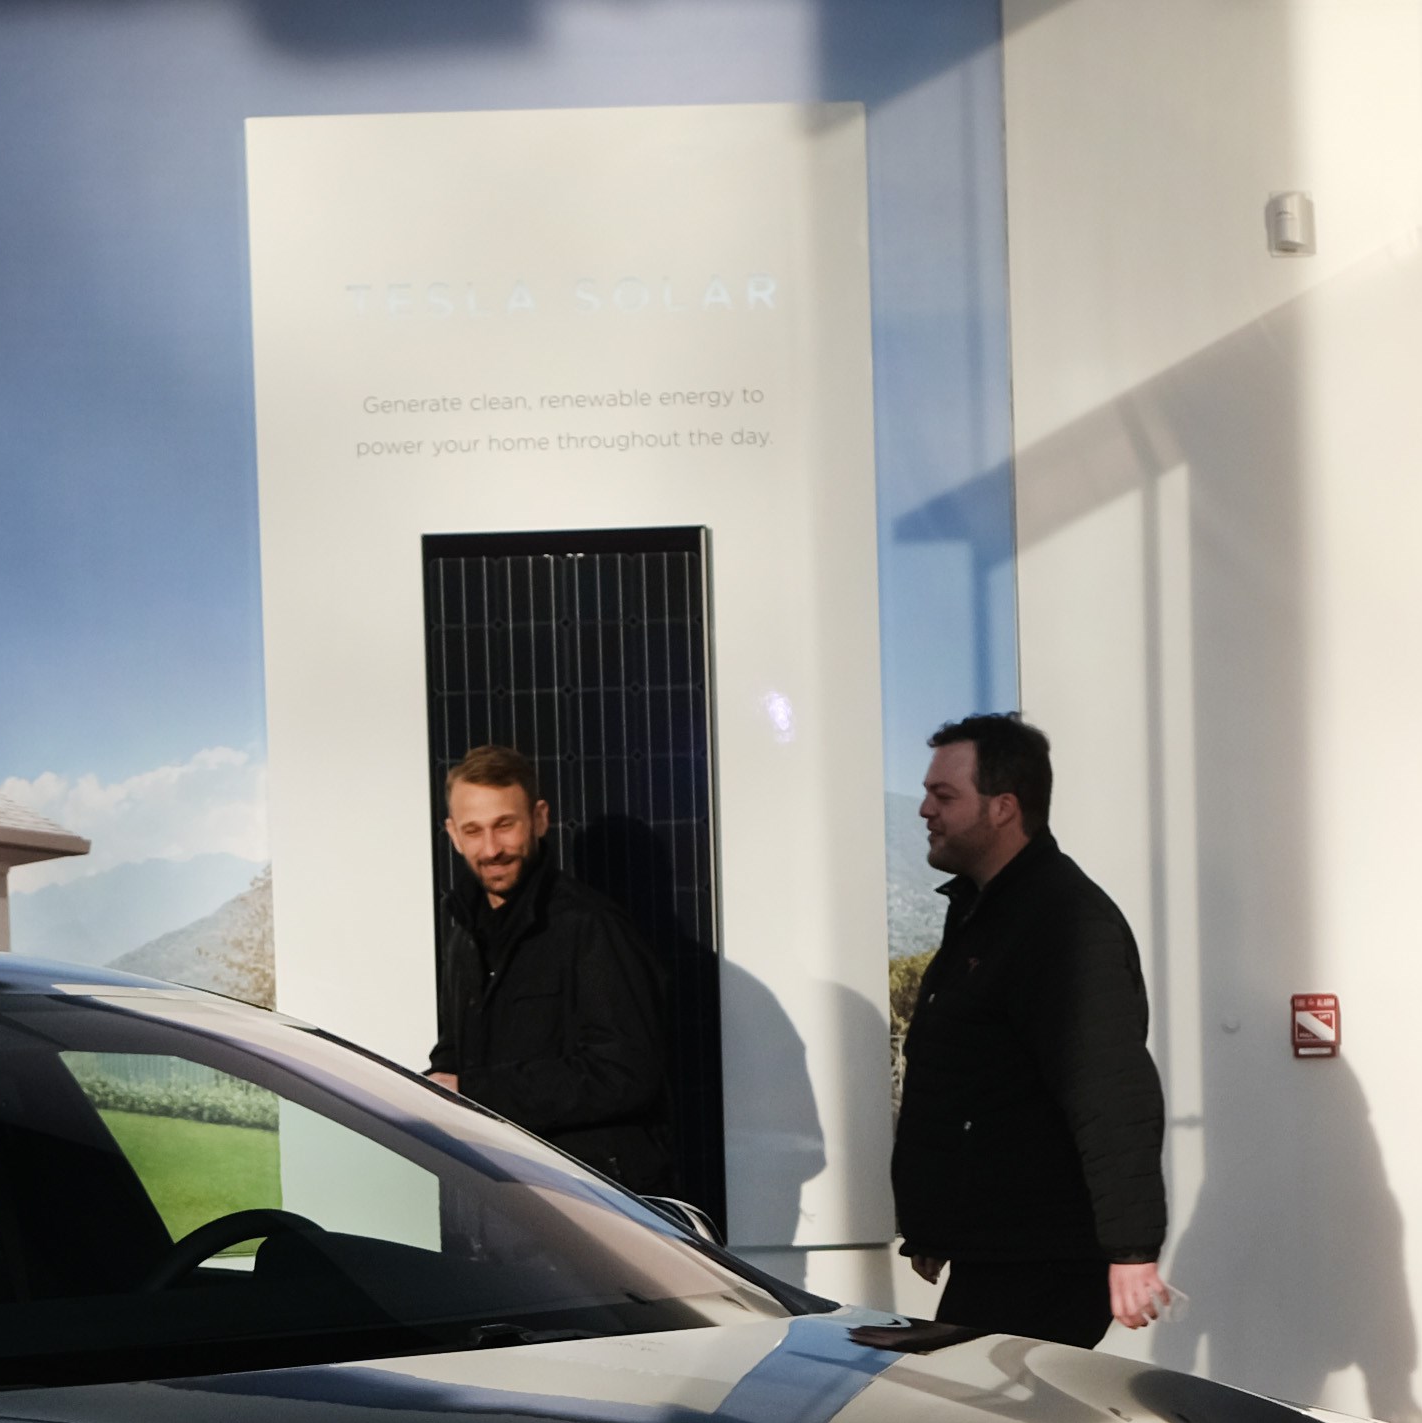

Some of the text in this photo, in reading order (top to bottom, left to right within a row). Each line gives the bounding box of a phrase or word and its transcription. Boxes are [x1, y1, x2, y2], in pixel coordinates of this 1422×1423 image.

[345, 274, 778, 318] TESLA SOLAR
[363, 387, 765, 415] Generate clean, renewable energy to
[356, 428, 773, 459] power your home throughout the day.
